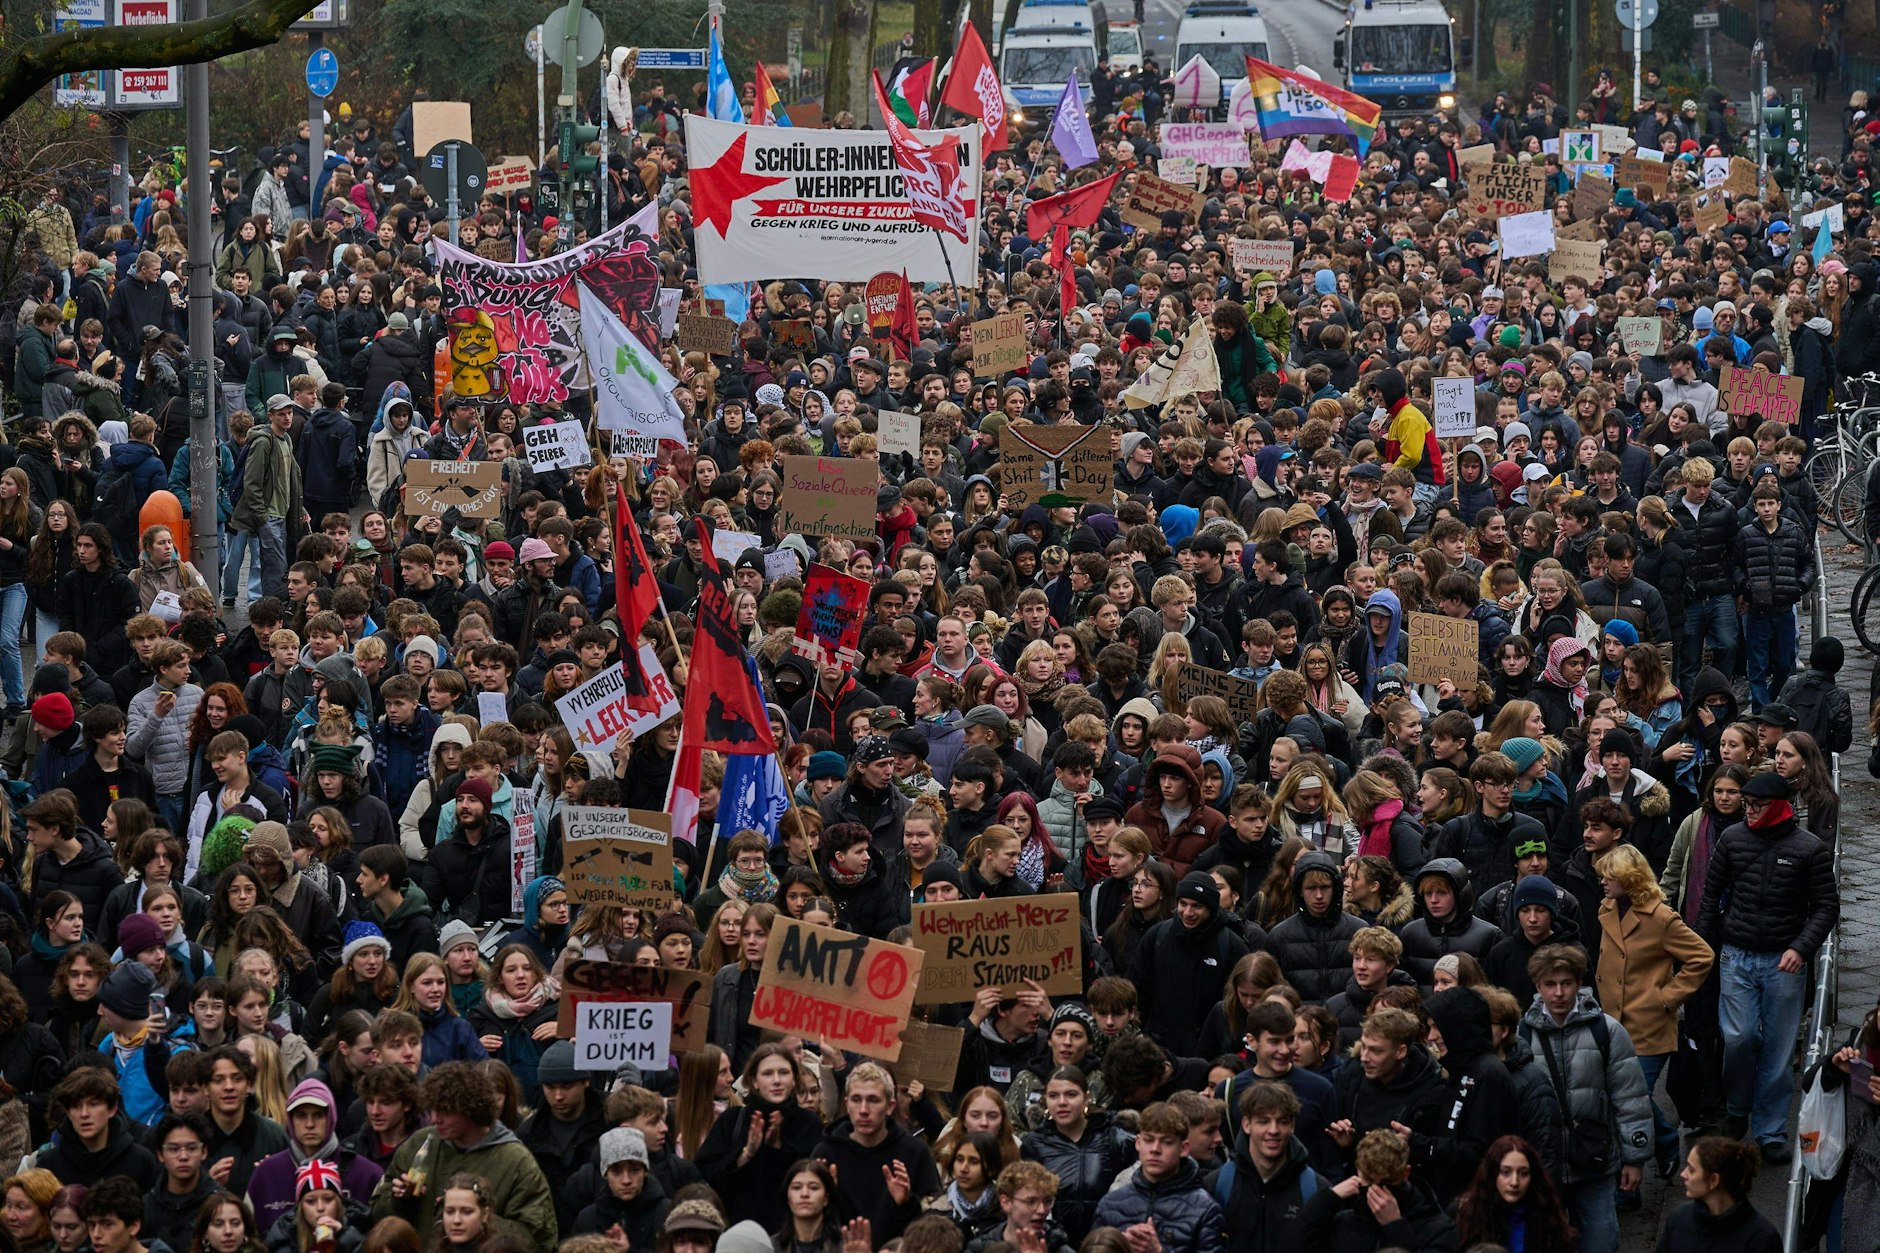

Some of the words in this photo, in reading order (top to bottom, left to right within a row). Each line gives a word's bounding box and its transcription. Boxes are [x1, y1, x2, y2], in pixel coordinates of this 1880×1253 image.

[125, 10, 167, 25] Werbefläche
[134, 76, 145, 86] 259
[146, 75, 157, 86] 267
[158, 75, 167, 86] 111
[1372, 75, 1432, 84] POLIZEI
[1167, 126, 1192, 143] GH
[1490, 164, 1531, 178] EURE
[796, 175, 908, 198] WEHRPFLIC
[1476, 175, 1542, 192] PFLICHT
[1485, 187, 1534, 202] UNSER
[778, 201, 805, 214] FÜR
[809, 203, 864, 217] UNSERE
[750, 218, 797, 229] GEGEN
[799, 219, 839, 231] KRIEG
[842, 221, 871, 232] UND
[1235, 252, 1291, 268] Entscheidung
[681, 316, 709, 327] JEDER
[710, 318, 731, 330] TOTE
[682, 323, 713, 335] MENSCH
[714, 328, 728, 340] IST
[973, 329, 993, 344] MEIN
[995, 316, 1023, 341] LEBEN
[680, 336, 704, 349] EINER
[975, 353, 991, 368] MEINE
[1436, 383, 1464, 399] Fragt
[1730, 367, 1791, 400] PEACE
[1717, 389, 1731, 412] IS
[1732, 393, 1799, 425] CHEAPER
[889, 414, 910, 431] Bildung
[525, 428, 560, 448] GEH
[529, 446, 567, 465] SELBER
[1003, 450, 1034, 464] Same
[1070, 450, 1113, 463] different
[430, 461, 480, 474] FREIHEIT
[1004, 466, 1035, 485] Shit
[1074, 465, 1108, 495] Day
[413, 488, 432, 506] IST
[431, 500, 451, 514] EIN
[455, 499, 484, 515] HOHES
[483, 484, 499, 503] GUT
[1411, 638, 1478, 662] STIMMUNG
[1411, 655, 1430, 664] STATT
[1178, 664, 1229, 692] MEINE
[1412, 663, 1478, 683] EINBERUFUNG
[566, 668, 625, 715] WEHRPFLIC
[585, 672, 675, 746] LECKR
[568, 811, 579, 823] IN
[586, 811, 627, 824] UNSEREN
[570, 823, 667, 842] GESCHICHTSBÜCHERN
[651, 878, 672, 892] FÜR
[573, 888, 673, 911] WIEDERHOLUNGEN
[919, 903, 1070, 940] Wehrpflicht-Merz
[946, 934, 1010, 960] RAUS
[1015, 928, 1061, 956] AUS
[777, 923, 870, 987] ANTI
[564, 959, 671, 997] GEGEN
[924, 965, 967, 991] DEM
[588, 1008, 653, 1031] KRIEG
[609, 1032, 627, 1040] IST
[586, 1041, 655, 1062] DUMM
